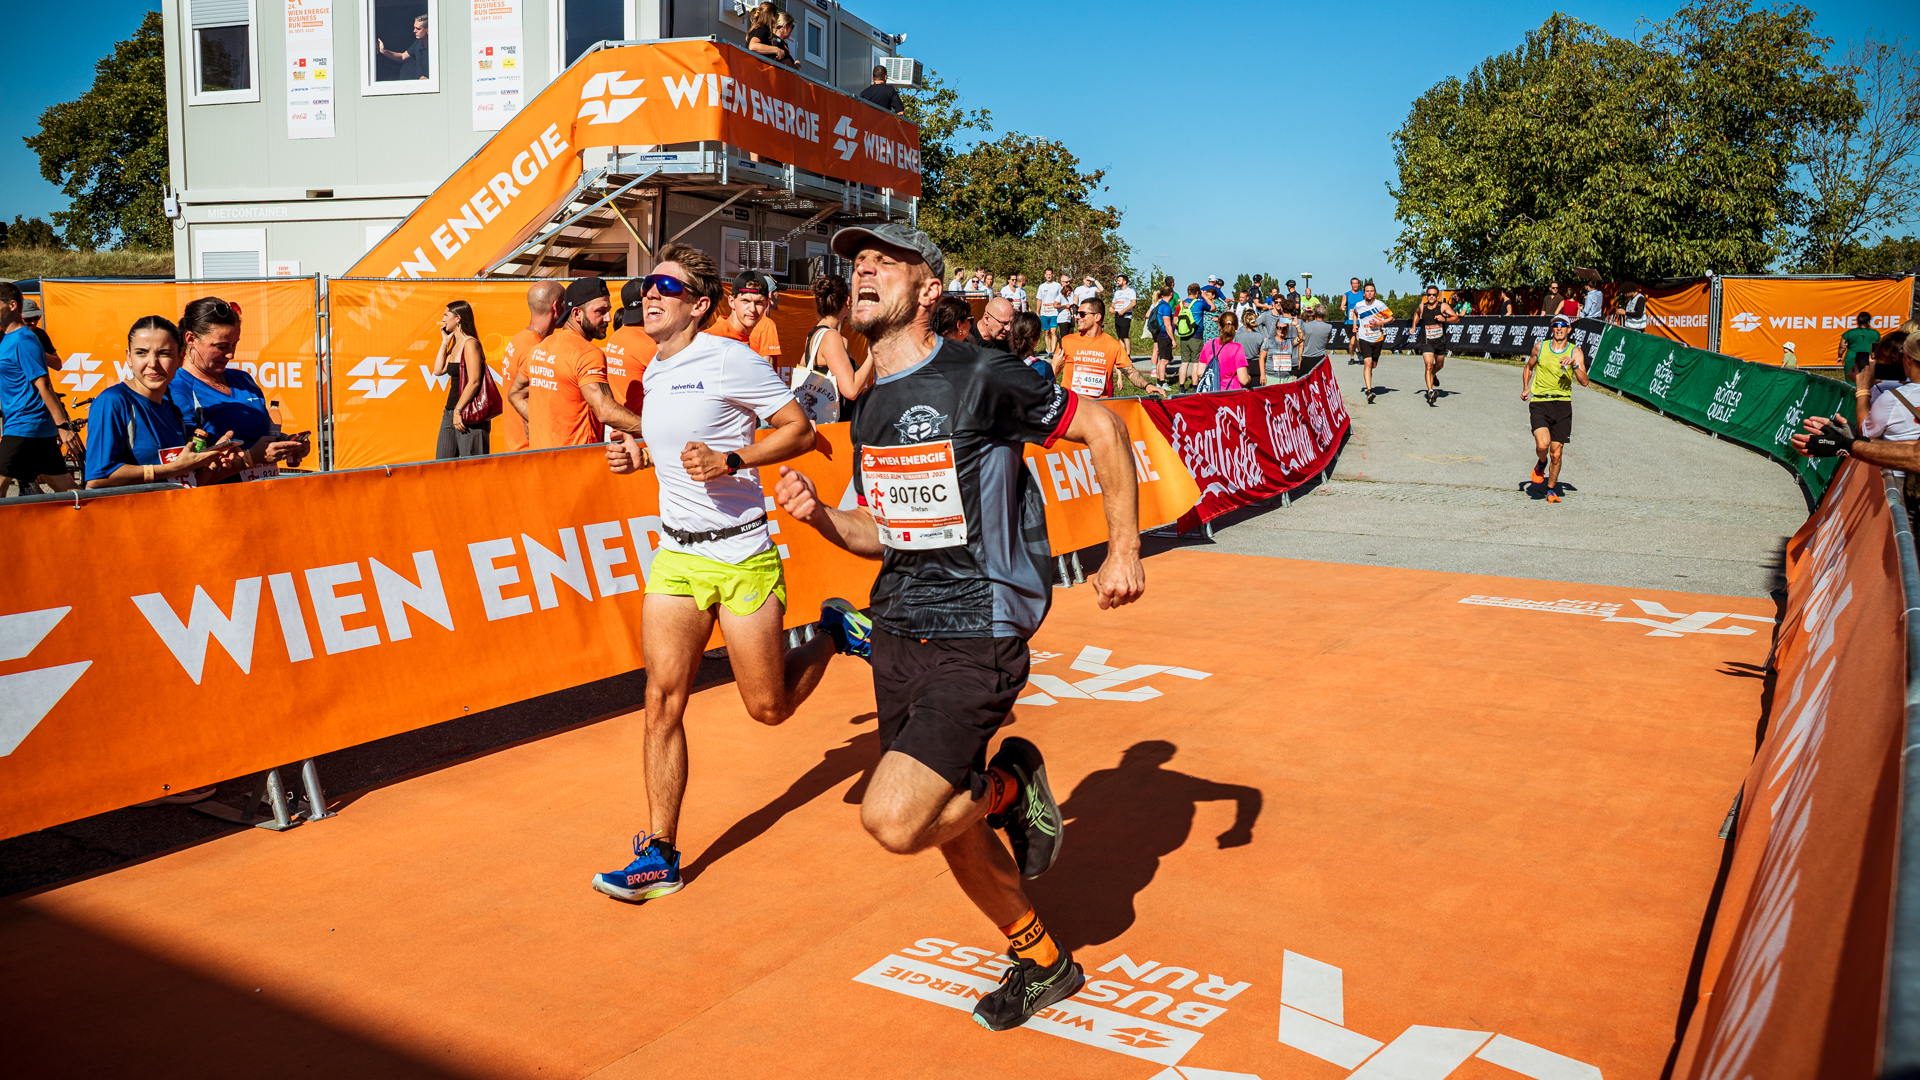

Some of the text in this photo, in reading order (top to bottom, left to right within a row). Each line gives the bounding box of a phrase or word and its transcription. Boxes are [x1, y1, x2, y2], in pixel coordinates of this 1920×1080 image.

[474, 1, 505, 9] BUSINESS
[662, 73, 820, 144] WIEN ENERGIE
[864, 130, 895, 167] WIEN
[430, 122, 569, 261] ENERGIE
[207, 206, 288, 219] MIETCONTAINER
[1668, 314, 1708, 328] ENERGIE
[1768, 315, 1901, 329] WIEN ENEGIE
[1445, 325, 1464, 333] POWER
[1467, 325, 1484, 334] POWER
[1487, 325, 1506, 335] POWER
[1509, 325, 1528, 336] POWER
[1531, 326, 1549, 337] POWER
[1076, 350, 1105, 358] LAUFEND
[1082, 357, 1107, 365] EINSATZ
[531, 377, 558, 391] EINSATZ
[1084, 376, 1103, 384] 4516A
[817, 386, 835, 402] READ
[1041, 394, 1062, 425] Region
[877, 452, 946, 466] WIEN ENERGIE
[1045, 440, 1160, 502] ENEIE
[889, 484, 948, 504] 9076C
[131, 550, 455, 685] WIEN
[626, 869, 669, 886] BROOKS
[1096, 953, 1253, 1001] RUN
[1034, 1007, 1094, 1032] WIE
